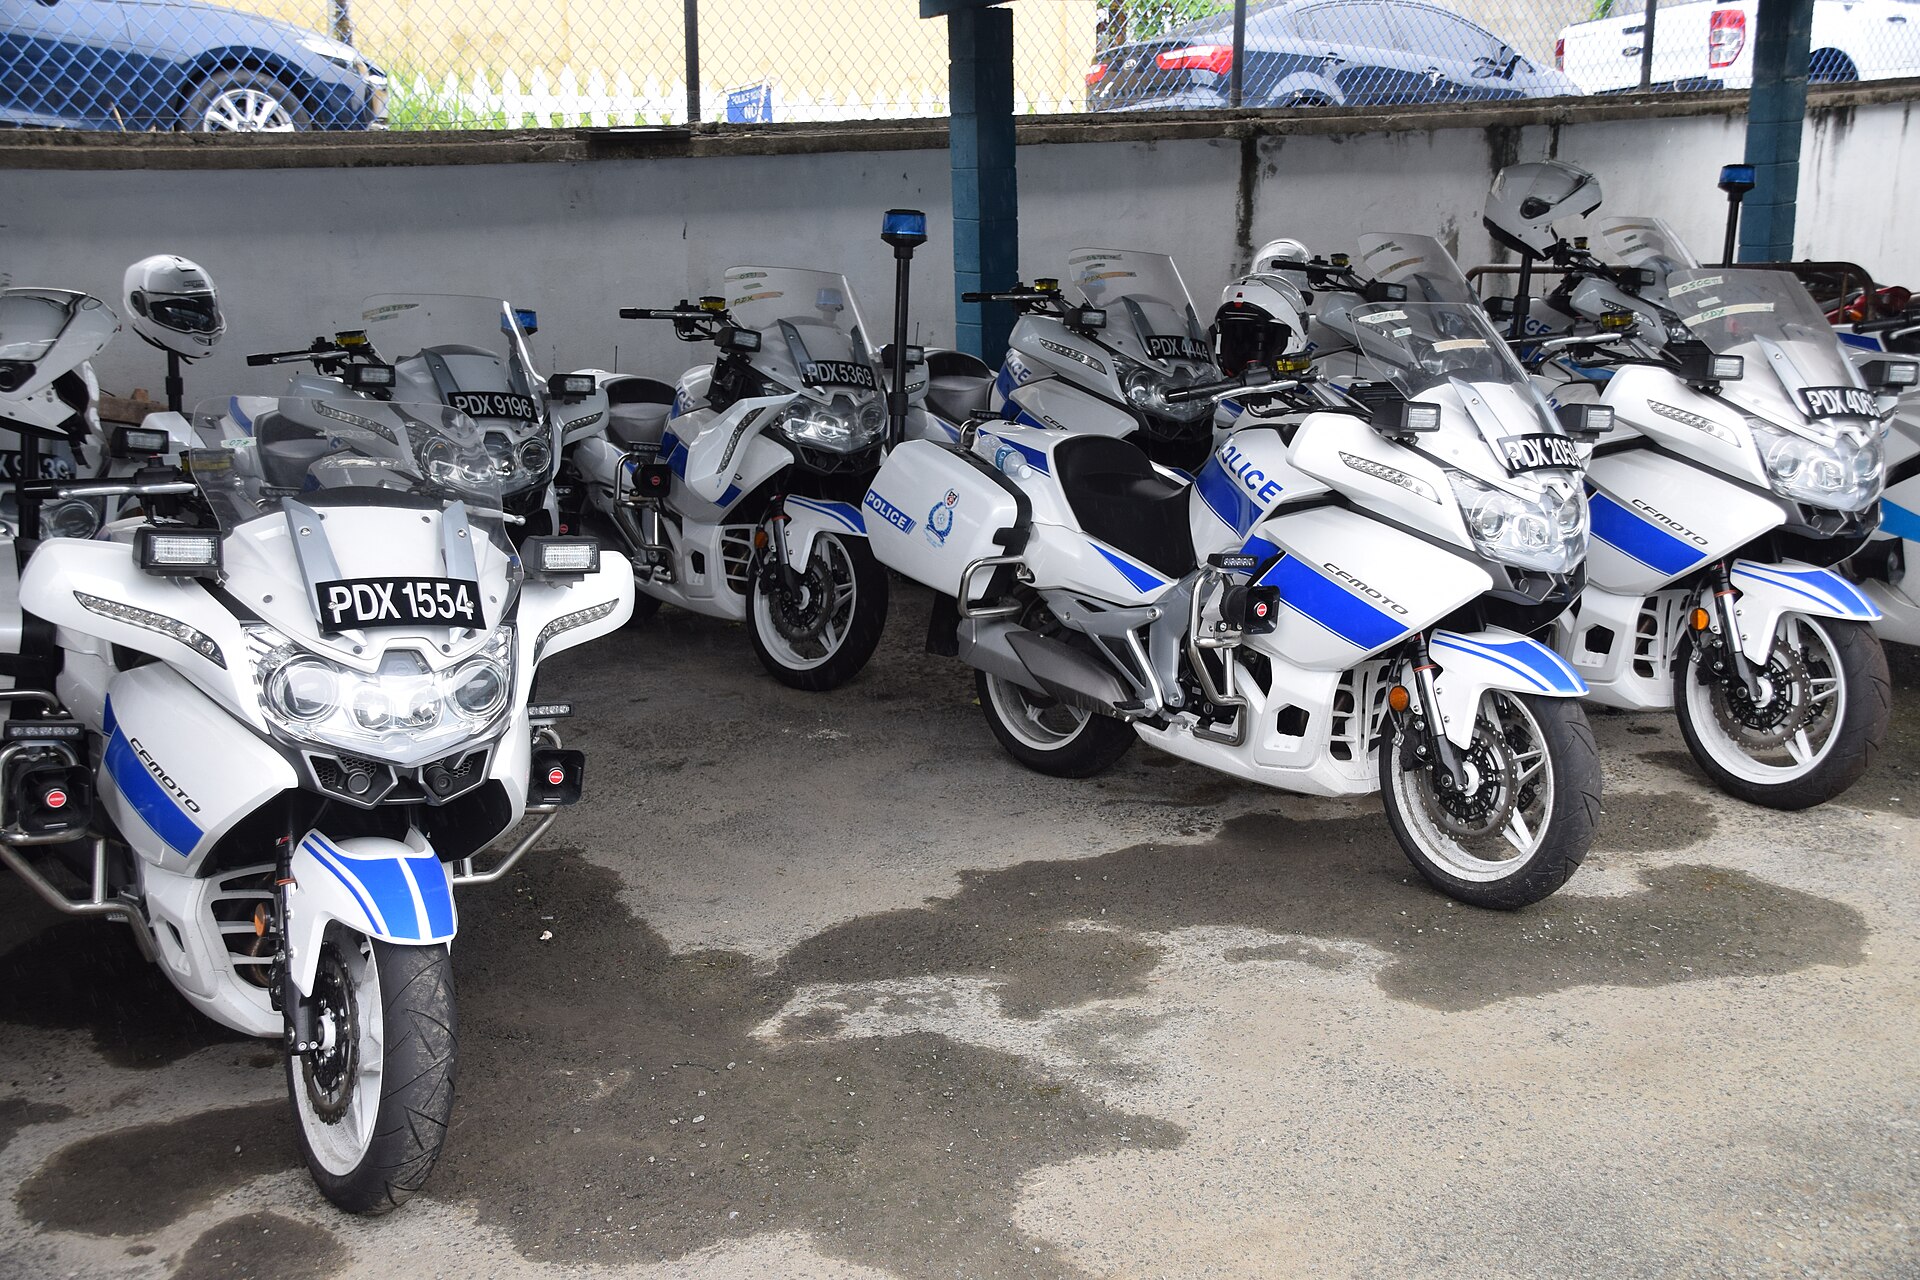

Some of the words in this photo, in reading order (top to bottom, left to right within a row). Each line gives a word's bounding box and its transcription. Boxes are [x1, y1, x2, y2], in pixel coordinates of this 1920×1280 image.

[1150, 338, 1181, 357] PDX
[806, 363, 840, 382] PDX
[839, 364, 873, 387] 5369
[454, 395, 494, 416] PDX
[493, 395, 532, 418] 9196
[1805, 389, 1849, 415] PDX
[1503, 438, 1552, 470] PDX
[1218, 445, 1284, 505] OLICE
[866, 492, 908, 529] POLICE
[1631, 499, 1709, 546] CFMOTO
[328, 582, 402, 624] PDX
[401, 581, 474, 620] 1554
[1323, 562, 1409, 615] CFMOTO
[130, 737, 202, 814] CFMOTO
